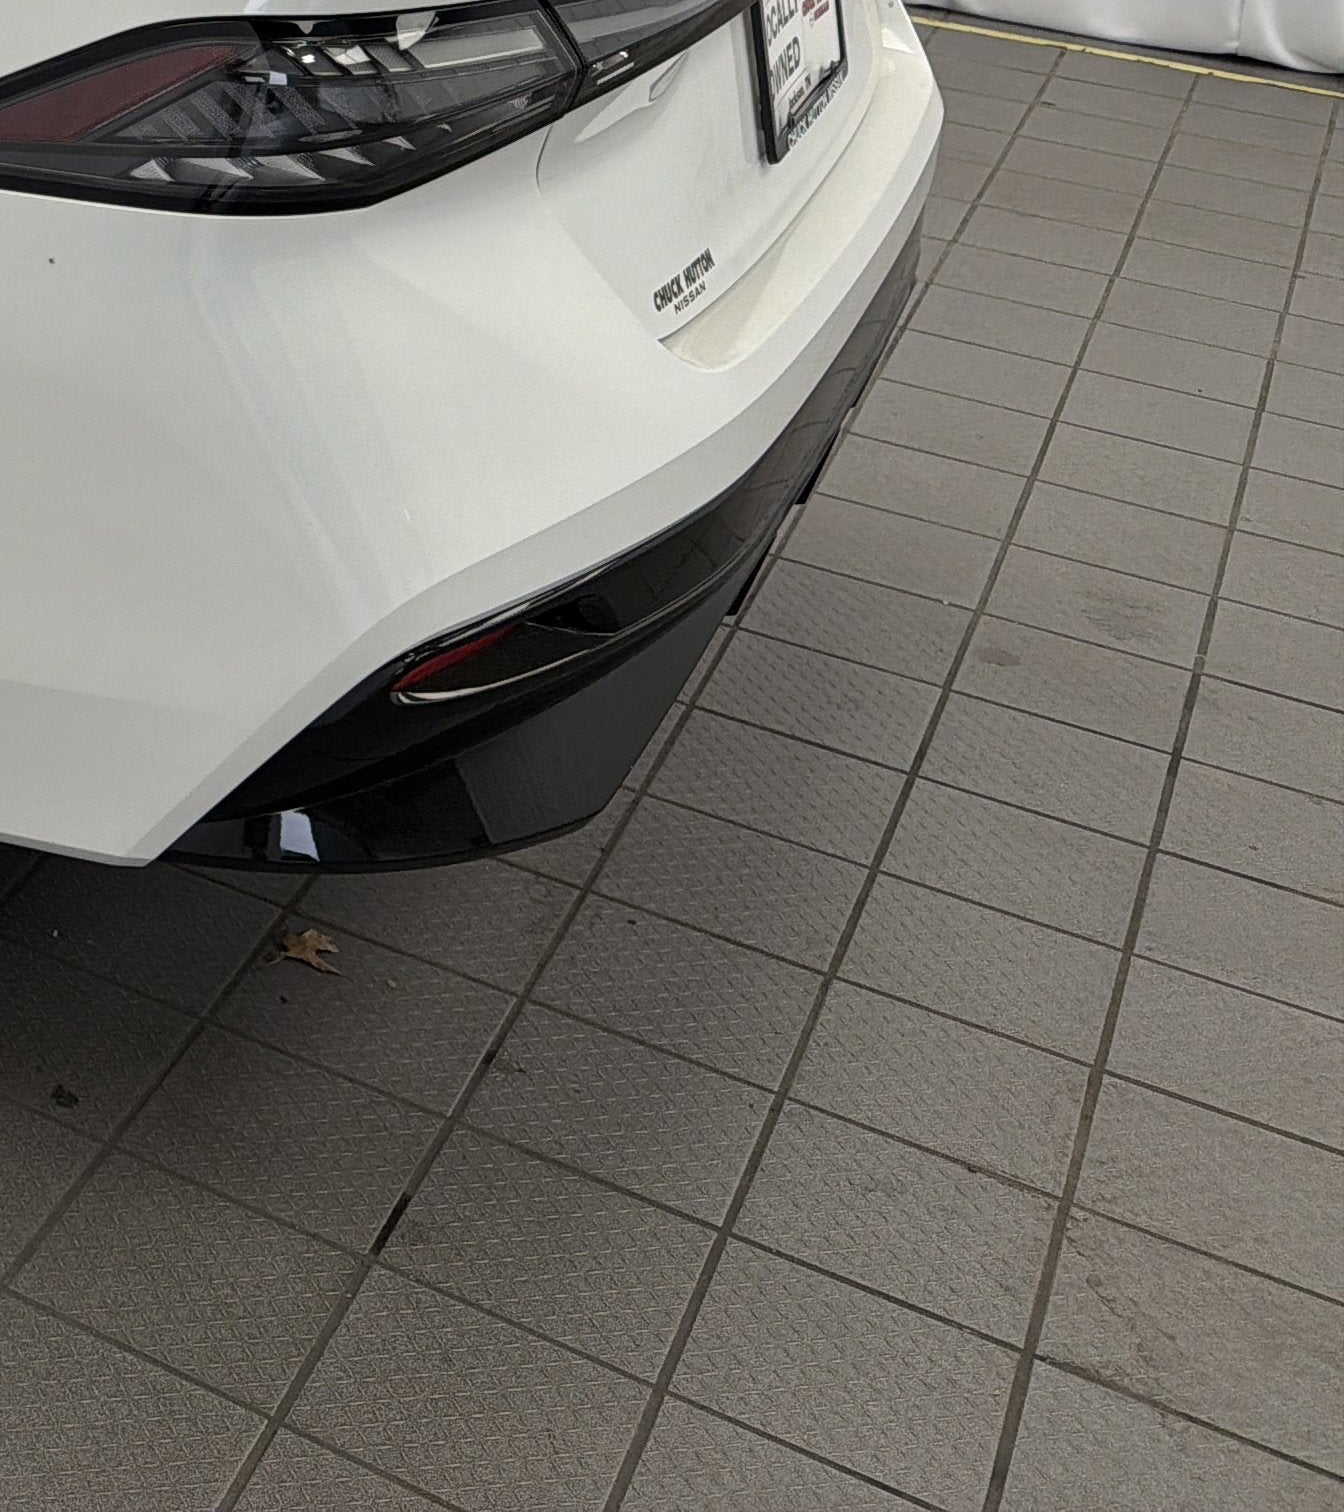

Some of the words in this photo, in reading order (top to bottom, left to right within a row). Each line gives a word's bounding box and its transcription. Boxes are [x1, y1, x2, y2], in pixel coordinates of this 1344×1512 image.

[653, 273, 685, 312] CHUCK
[683, 247, 716, 289] HUTTON
[674, 280, 707, 315] NISSAN
